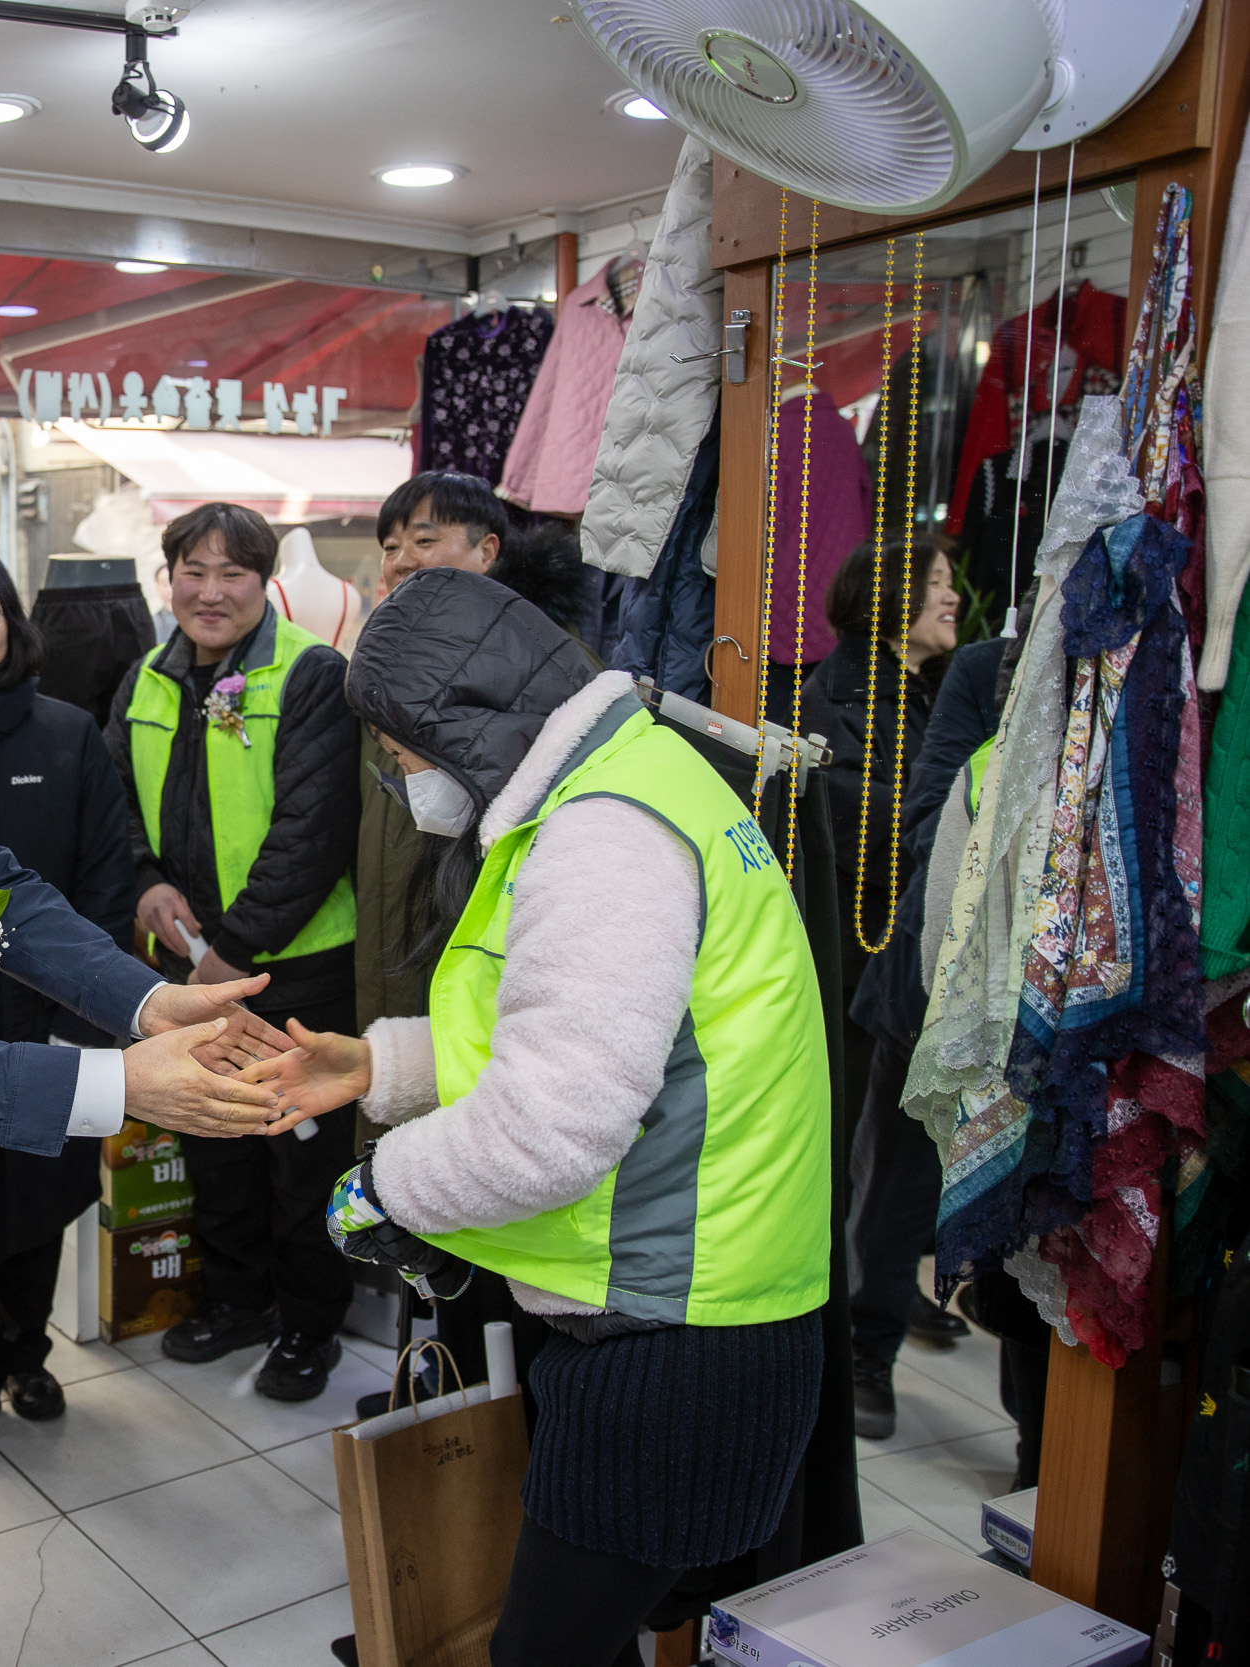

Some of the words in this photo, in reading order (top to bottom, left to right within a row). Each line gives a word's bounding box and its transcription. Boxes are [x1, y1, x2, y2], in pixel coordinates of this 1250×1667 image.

[11, 775, 43, 785] Dickies
[152, 1157, 186, 1183] 배
[151, 1254, 182, 1279] 배
[925, 1589, 980, 1613] OMAR
[870, 1609, 932, 1639] SHARIF
[730, 1636, 761, 1662] 아로마
